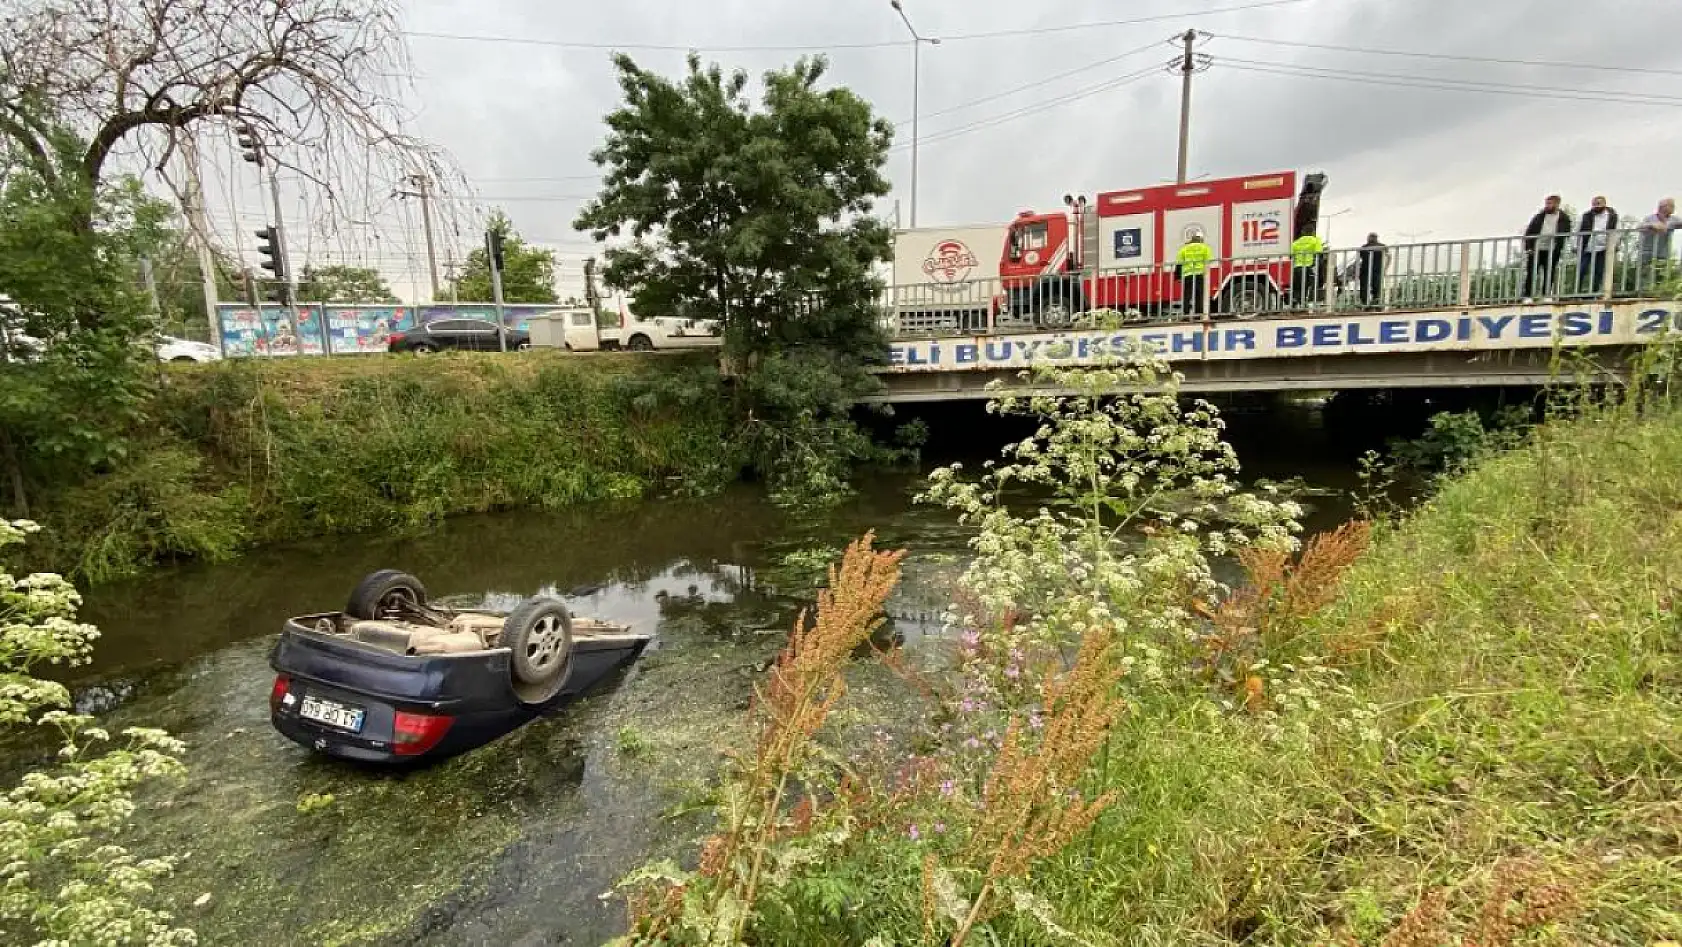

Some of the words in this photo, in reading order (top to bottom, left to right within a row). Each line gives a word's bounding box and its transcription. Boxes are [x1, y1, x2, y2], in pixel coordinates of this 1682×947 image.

[1242, 220, 1280, 241] 112
[889, 339, 940, 364] ELİ
[1636, 308, 1682, 334] 2
